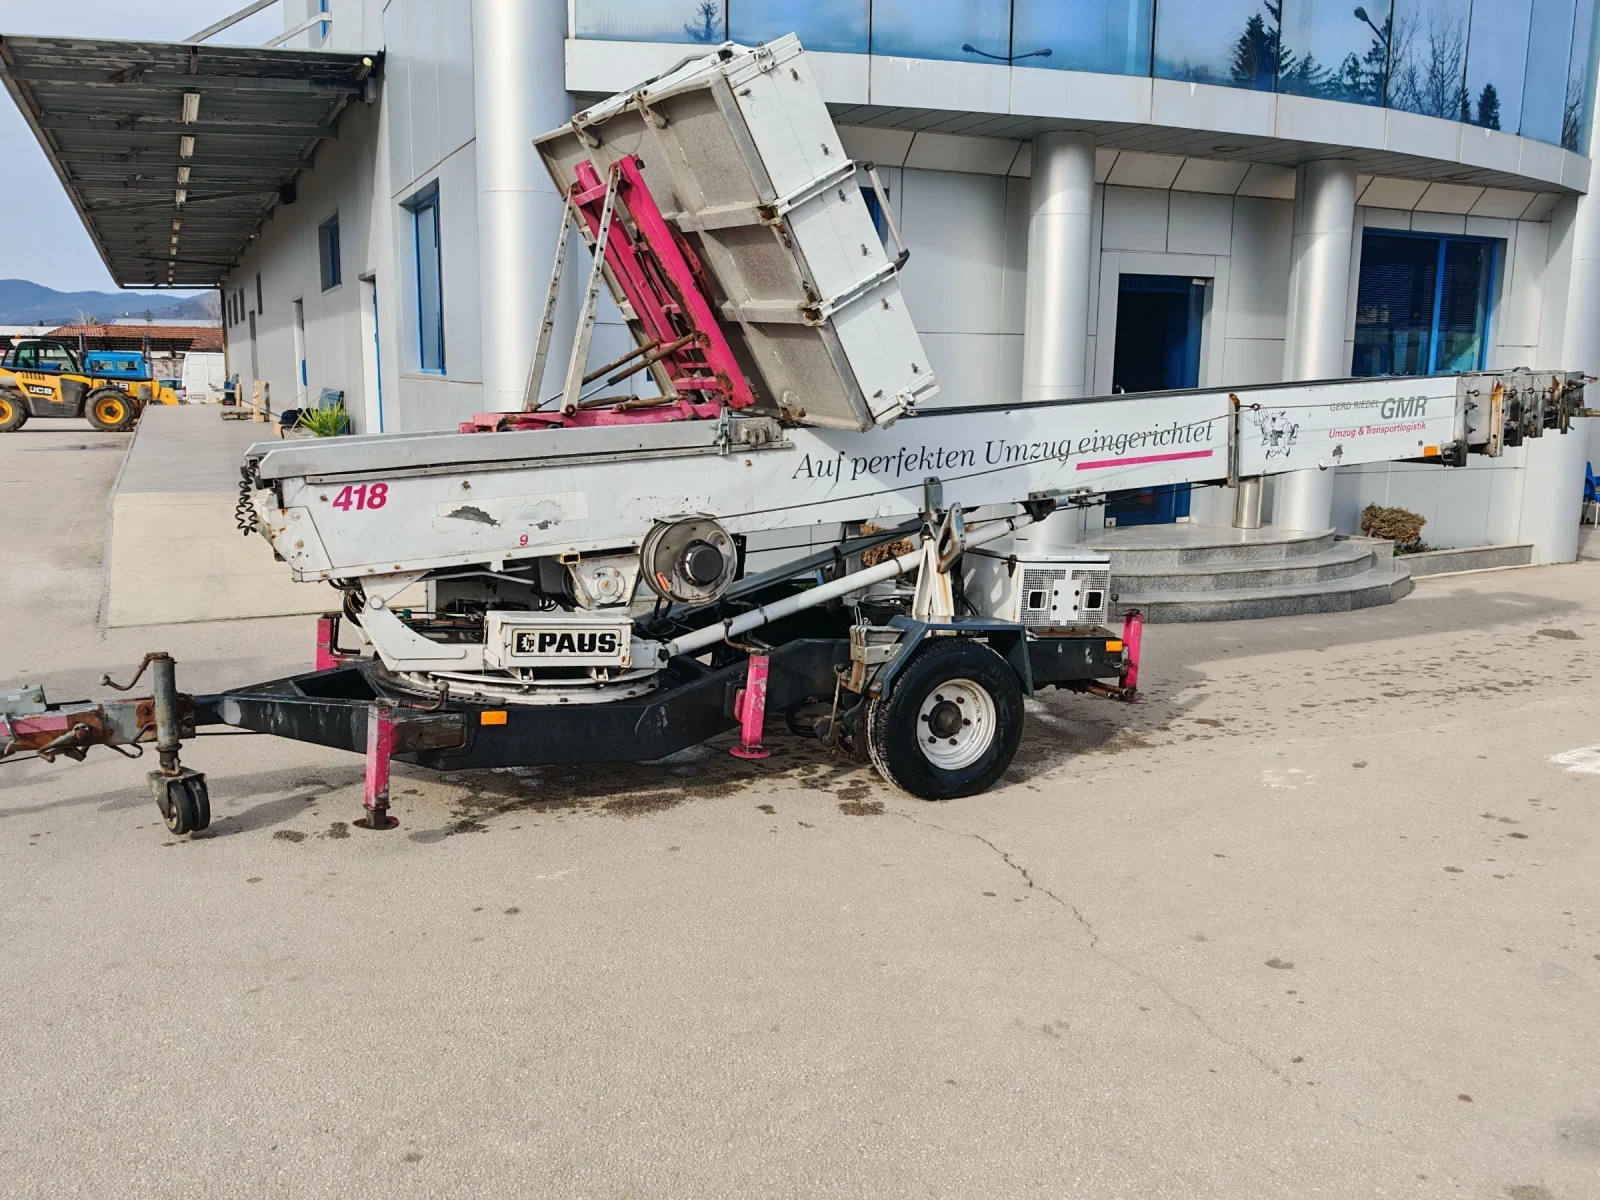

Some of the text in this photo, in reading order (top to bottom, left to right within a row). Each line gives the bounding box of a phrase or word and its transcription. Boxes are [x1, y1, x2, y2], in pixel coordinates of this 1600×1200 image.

[29, 386, 53, 395] JCB
[1330, 396, 1428, 419] GERD RIEDEL GMR
[1329, 421, 1426, 438] Umzug & Transportlogistik
[791, 421, 1214, 482] Auf perfekten Umzug eingerichtet
[332, 483, 389, 511] 418
[520, 534, 529, 546] 9
[538, 633, 616, 653] PAUS
